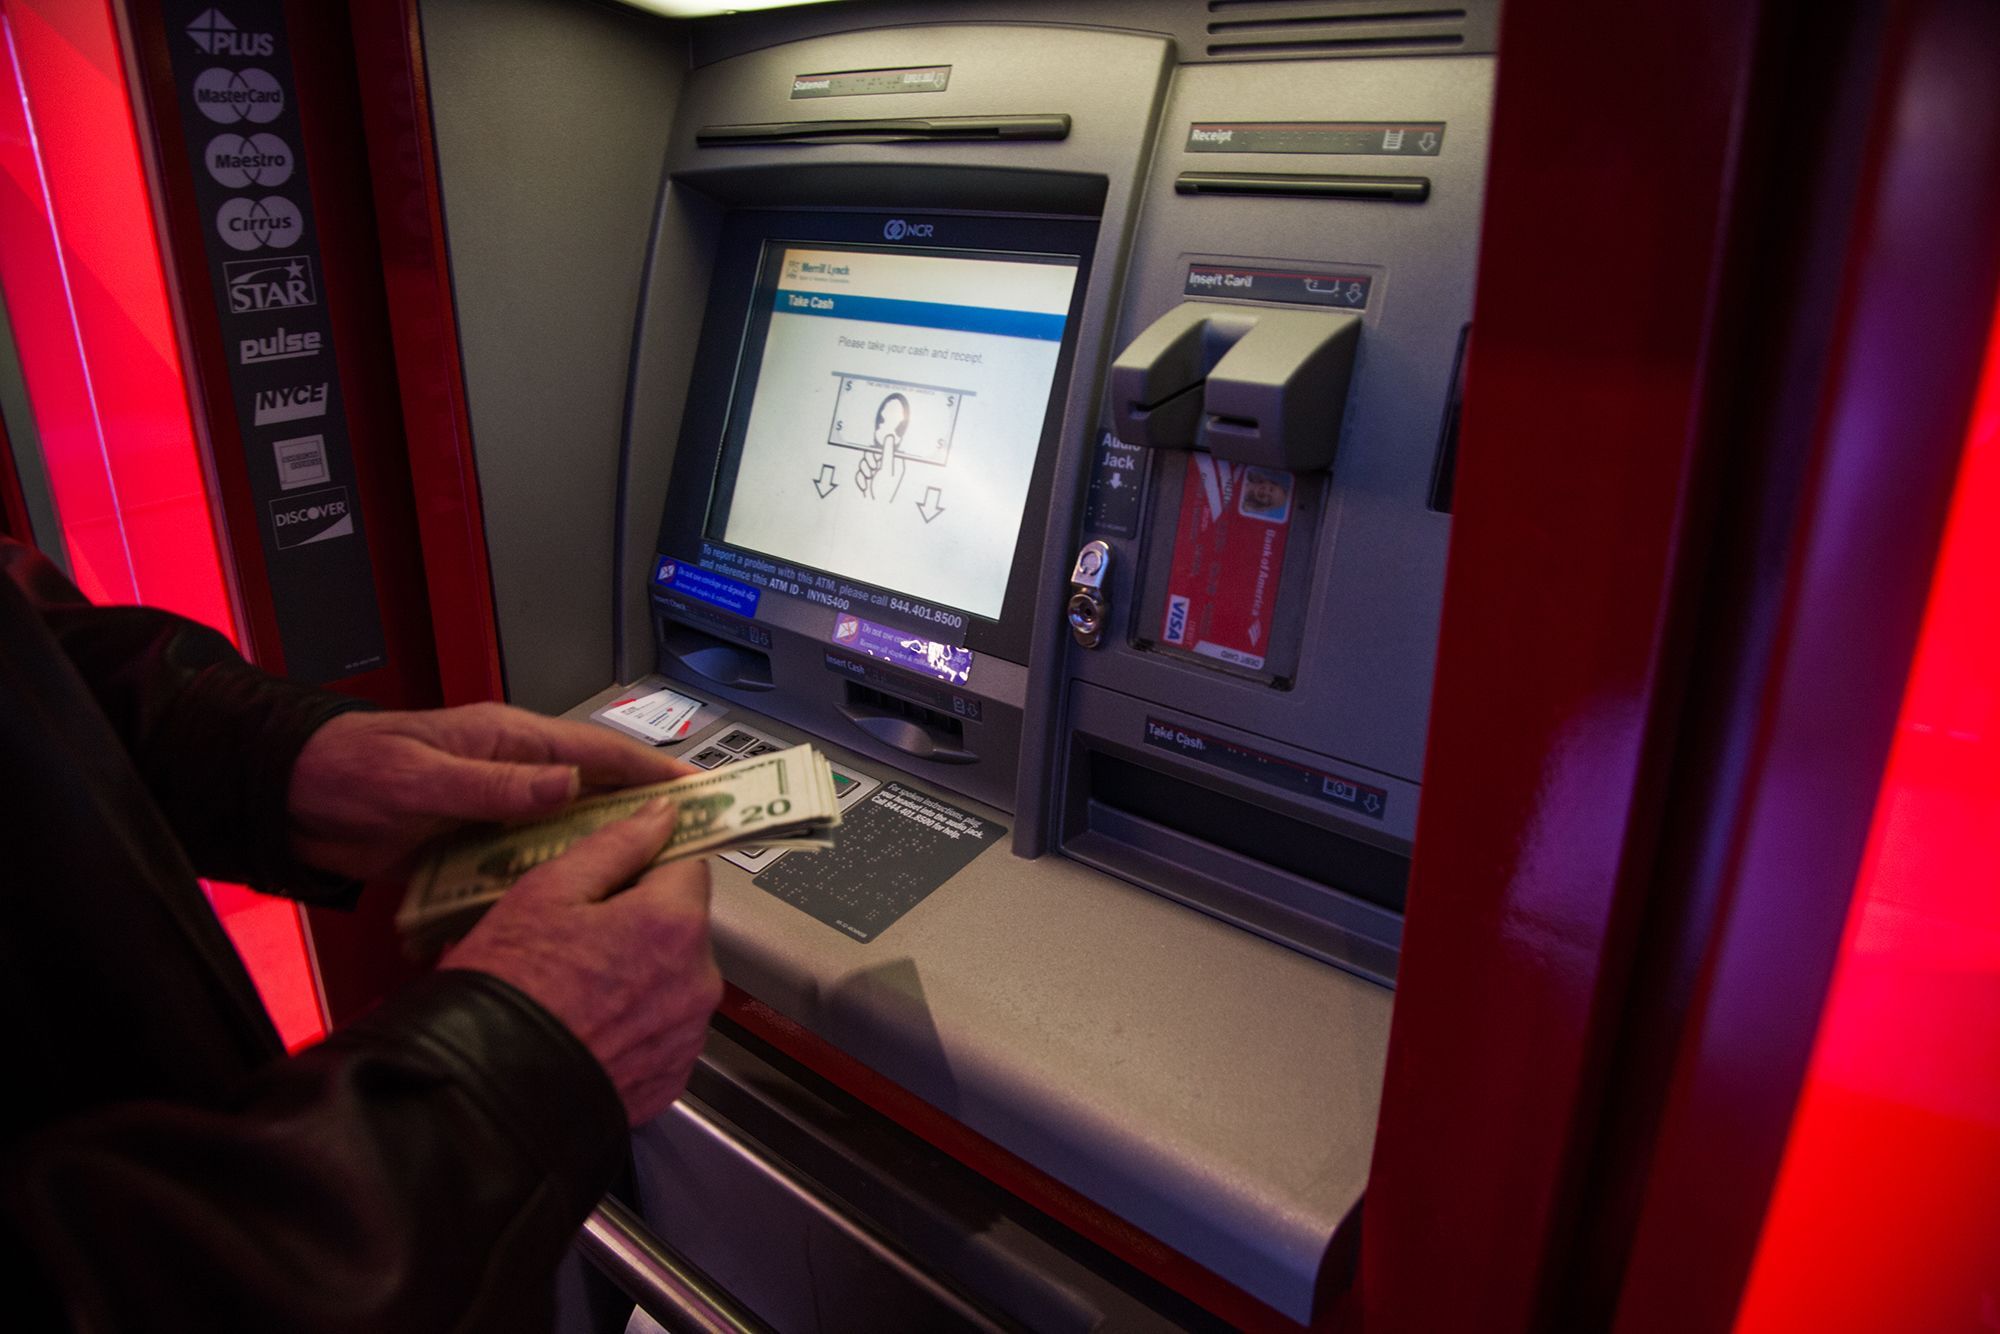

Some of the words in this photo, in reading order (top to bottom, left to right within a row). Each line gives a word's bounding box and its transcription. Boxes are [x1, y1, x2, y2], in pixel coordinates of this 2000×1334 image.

[213, 32, 274, 56] PLUS
[198, 88, 281, 103] MasterCard
[1191, 129, 1233, 144] Receipt
[215, 153, 286, 169] Maestro
[229, 216, 292, 232] Cirrus
[906, 224, 934, 238] NCR
[801, 262, 826, 273] Merrill
[1189, 272, 1222, 286] Insert
[1224, 275, 1253, 288] Card
[231, 279, 310, 311] STAR
[789, 294, 809, 307] Take
[810, 297, 834, 309] Cash
[240, 327, 321, 362] pulse
[838, 335, 866, 349] Please
[867, 340, 885, 351] take
[886, 344, 906, 355] your
[907, 346, 929, 356] cash
[931, 349, 948, 359] and
[259, 384, 325, 410] NYCE
[1102, 452, 1135, 470] Jack
[275, 501, 346, 527] DISCOVER
[700, 559, 714, 570] and
[715, 563, 751, 581] reference
[752, 573, 768, 586] this
[769, 578, 788, 592] ATM
[789, 583, 800, 595] ID
[807, 589, 850, 611] INYN5400
[703, 543, 712, 555] To
[712, 549, 736, 561] report
[737, 556, 743, 564] a
[743, 558, 776, 574] problem
[777, 567, 796, 579] with
[797, 571, 813, 585] this
[839, 585, 869, 601] please
[871, 595, 888, 607] call
[890, 598, 962, 628] 844.401.8500
[862, 623, 871, 634] Do
[871, 627, 882, 637] not
[1168, 602, 1184, 640] VISA
[847, 660, 865, 675] Cash
[725, 734, 740, 744] 1
[1149, 723, 1174, 740] Take
[1176, 732, 1204, 749] Cash
[749, 745, 767, 755] 2
[740, 798, 791, 826] 20
[871, 795, 889, 806] Call
[884, 800, 936, 827] 844.401.8500
[931, 822, 945, 831] for
[878, 790, 895, 800] your
[893, 795, 922, 811] headset
[920, 806, 936, 817] into
[933, 813, 947, 822] the
[945, 819, 967, 831] audio
[888, 783, 900, 792] For
[899, 789, 924, 803] spoken
[962, 816, 983, 829] plug
